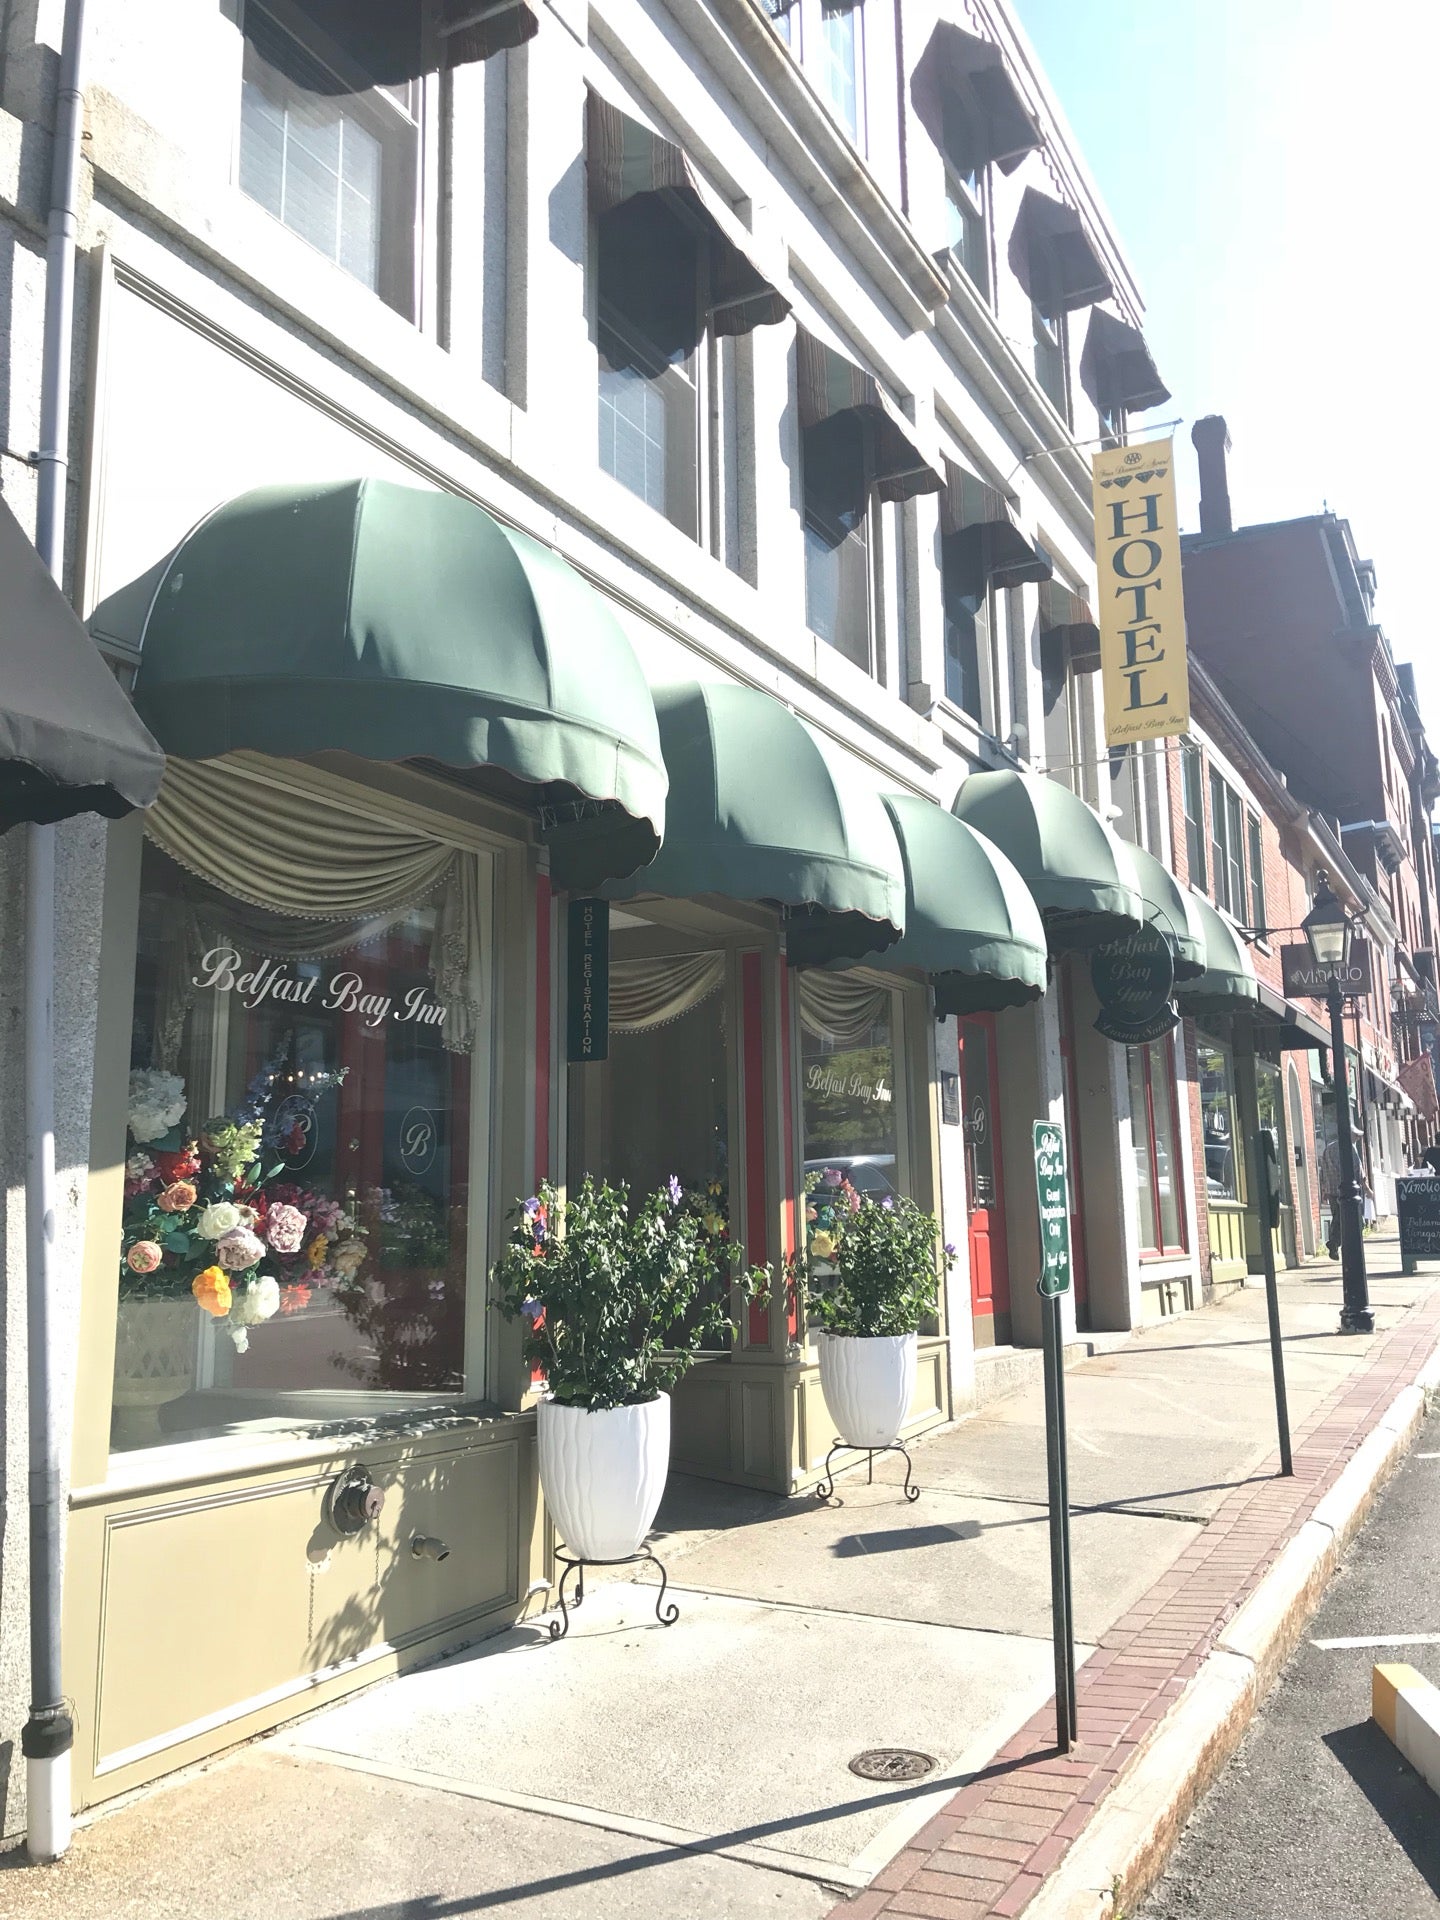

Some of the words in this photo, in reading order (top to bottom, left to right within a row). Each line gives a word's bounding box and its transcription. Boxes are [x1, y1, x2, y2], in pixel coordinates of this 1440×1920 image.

[1106, 493, 1168, 711] HOTEL
[1110, 724, 1142, 735] Belfast
[1144, 719, 1165, 729] Bay
[1166, 715, 1184, 725] Inn
[584, 906, 593, 946] HOTEL
[1098, 935, 1160, 959] Belfast
[1110, 962, 1151, 981] Bay
[192, 947, 318, 1009] Belfast
[322, 972, 391, 1026] Bay
[394, 987, 447, 1026] Inn
[1113, 986, 1152, 1002] Inn
[583, 953, 592, 1054] REGISTRATION
[806, 1064, 846, 1099] Belfast
[848, 1072, 872, 1104] Bay
[872, 1078, 892, 1103] Inn
[401, 1123, 431, 1157] B
[1040, 1156, 1053, 1181] Bay
[1049, 1223, 1061, 1238] Only
